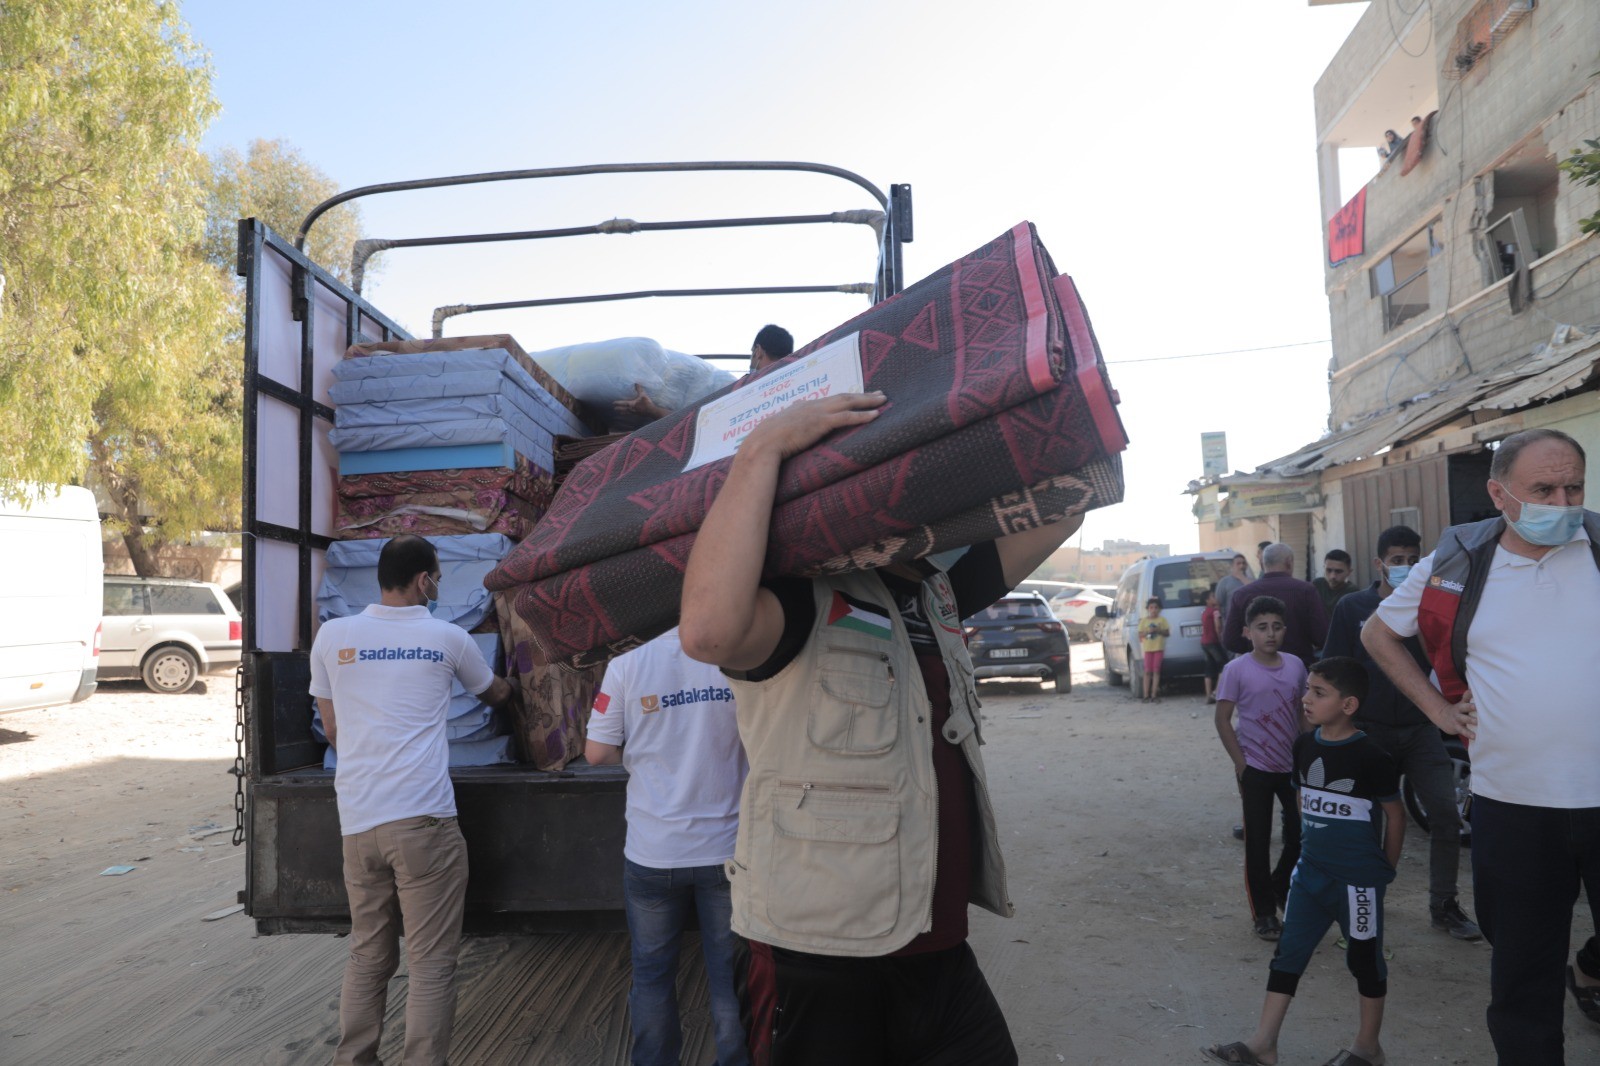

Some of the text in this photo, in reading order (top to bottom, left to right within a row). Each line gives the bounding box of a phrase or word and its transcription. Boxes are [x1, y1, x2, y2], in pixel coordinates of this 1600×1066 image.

[359, 646, 444, 663] sadakataşı
[1302, 793, 1352, 817] didas
[1355, 886, 1371, 933] adidas
